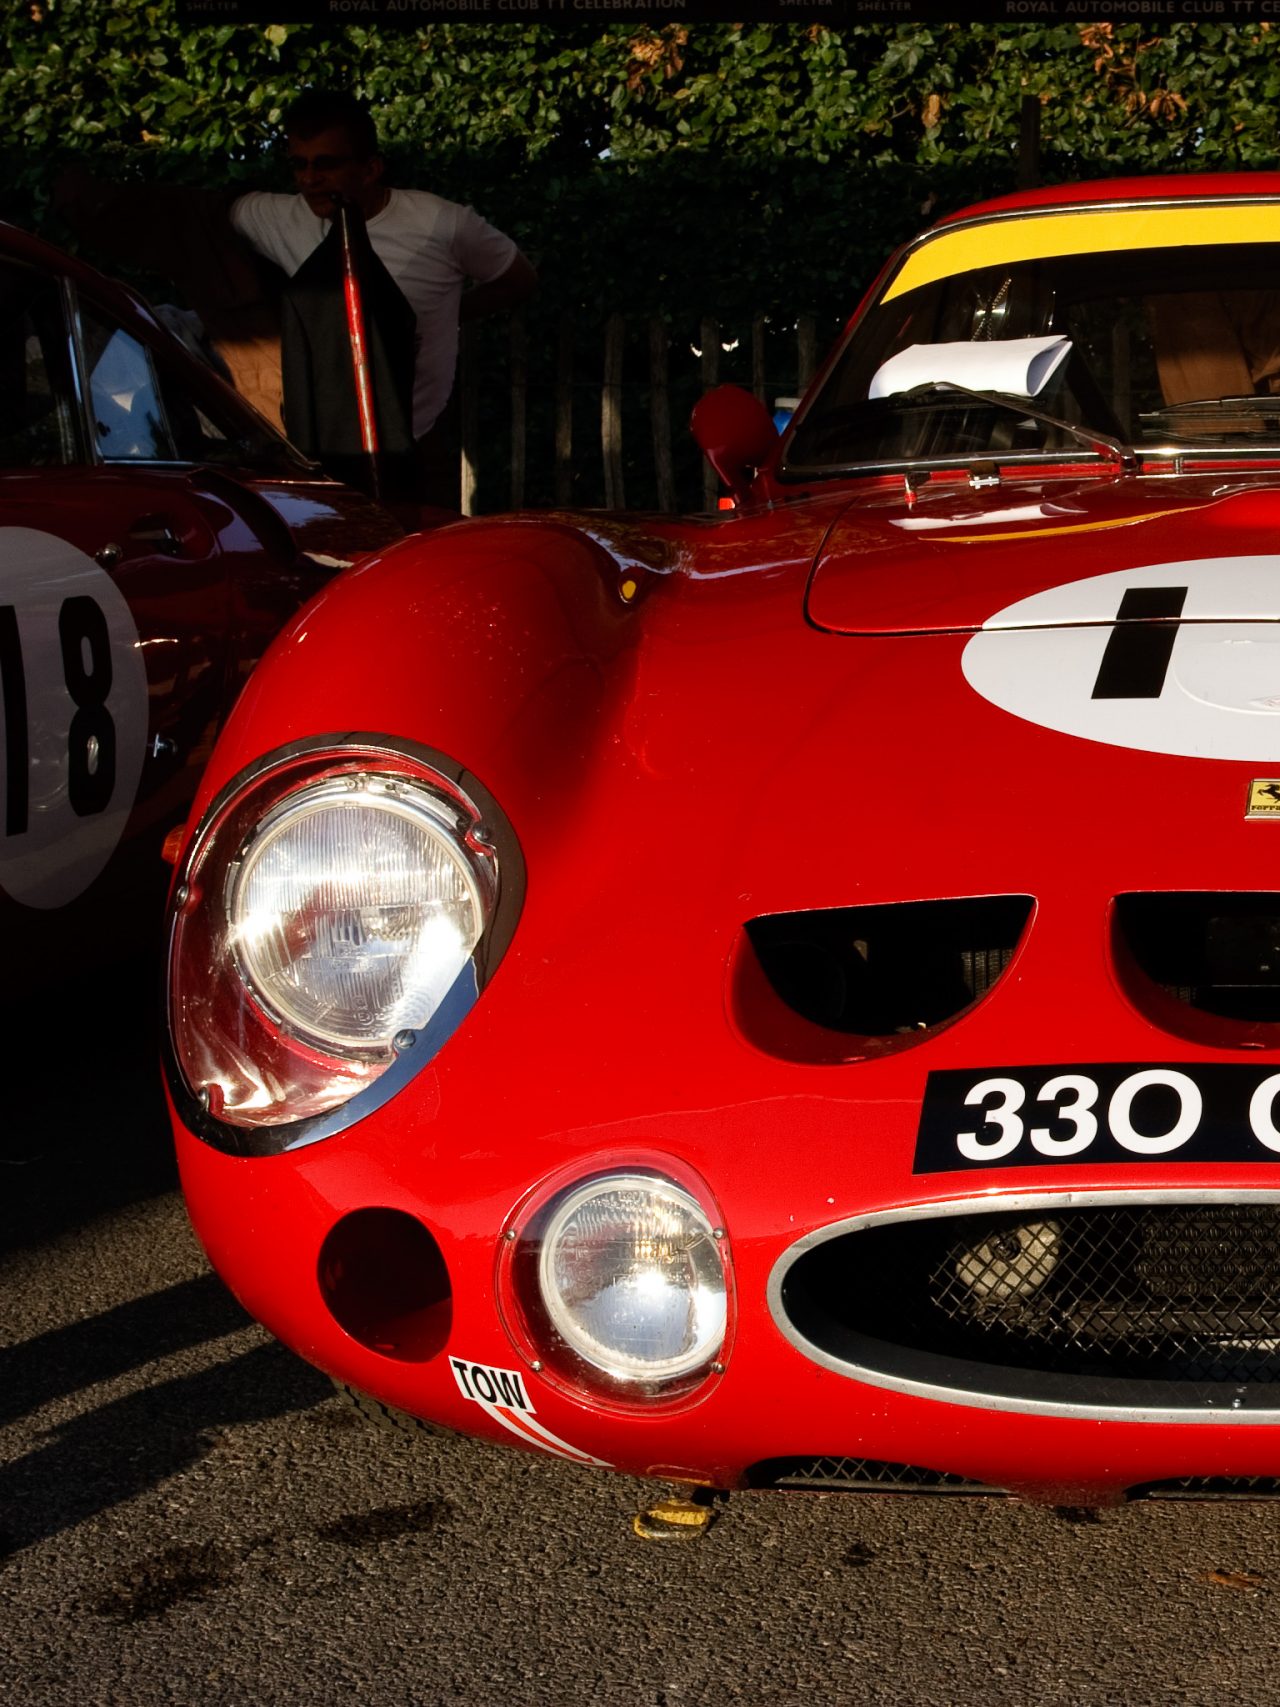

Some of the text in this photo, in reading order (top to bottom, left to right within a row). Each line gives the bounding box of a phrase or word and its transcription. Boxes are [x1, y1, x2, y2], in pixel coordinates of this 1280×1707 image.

[185, 1, 239, 11] SHELTER
[329, 0, 379, 12] ROYAL
[386, 0, 491, 11] AUTOMOBILE
[498, 0, 539, 10] CLUB
[573, 0, 686, 9] CELEBRATION
[857, 1, 911, 11] SHELTER
[1006, 1, 1058, 13] ROYAL
[1065, 1, 1175, 13] AUTOMOBILE
[1182, 1, 1225, 13] CLUB
[1231, 1, 1255, 13] TT
[0, 596, 115, 836] 18
[956, 1069, 1203, 1161] 330
[452, 1359, 527, 1409] TOW
